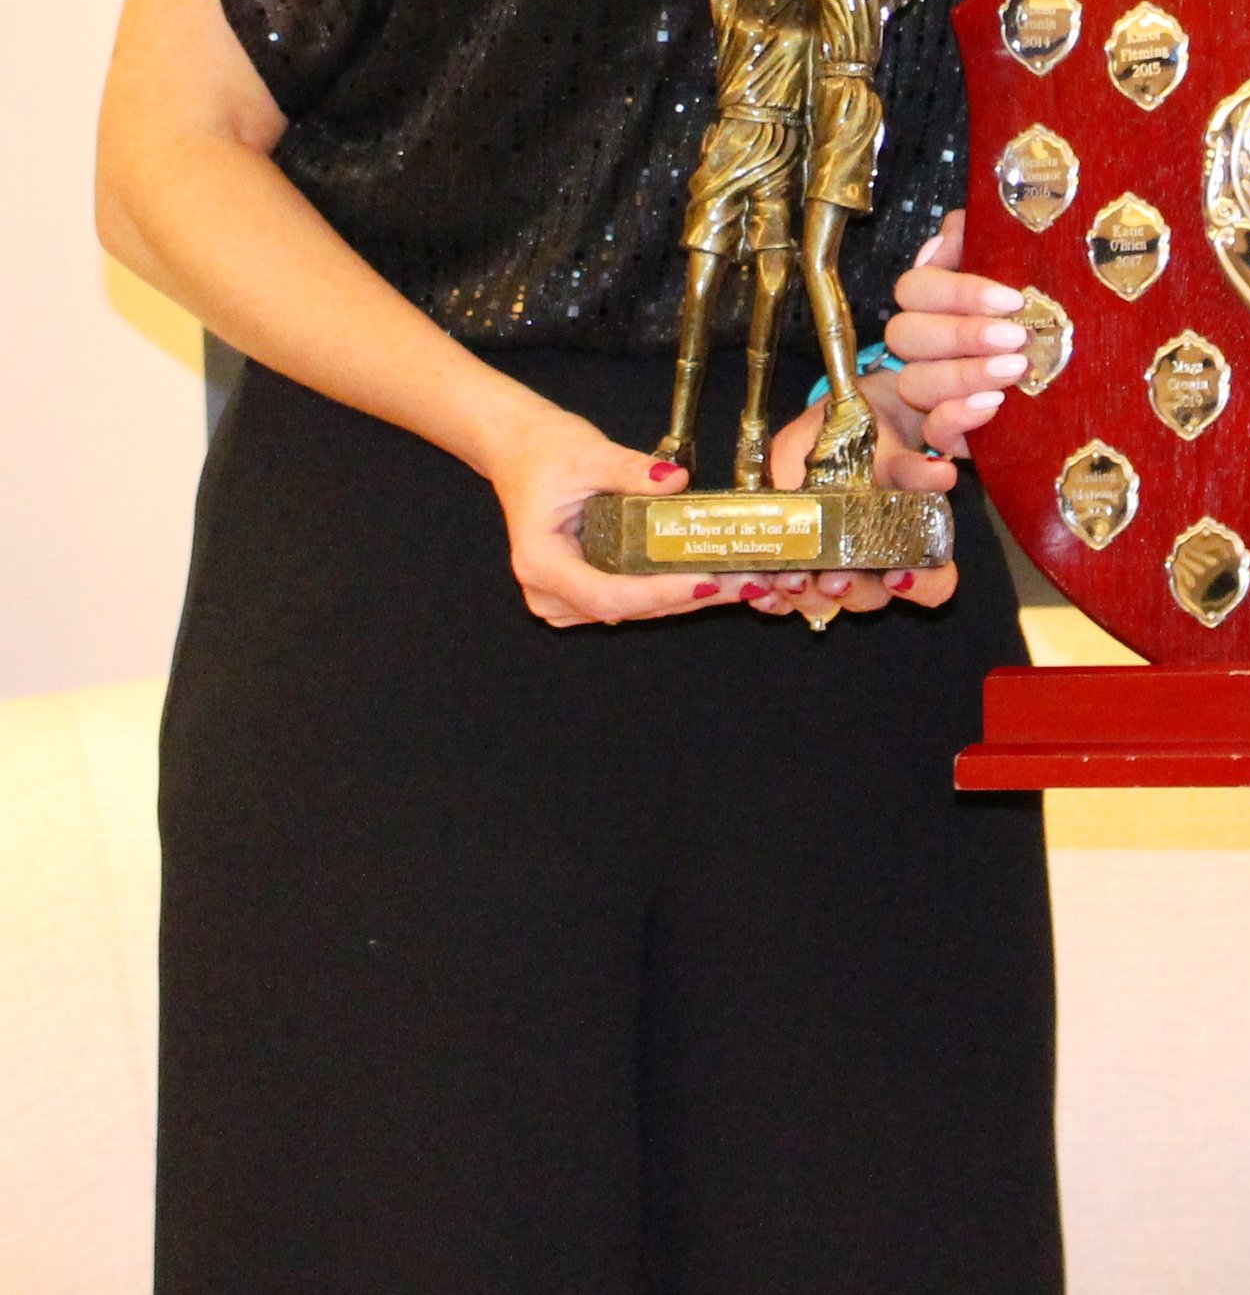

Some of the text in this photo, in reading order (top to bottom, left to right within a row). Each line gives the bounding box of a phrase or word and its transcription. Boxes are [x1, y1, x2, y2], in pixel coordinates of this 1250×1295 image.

[1131, 62, 1161, 78] 2015
[1110, 239, 1147, 252] O'Brien
[724, 523, 736, 535] of
[740, 522, 756, 535] the
[760, 522, 783, 534] Year
[682, 540, 784, 555] Aisling Mahony
